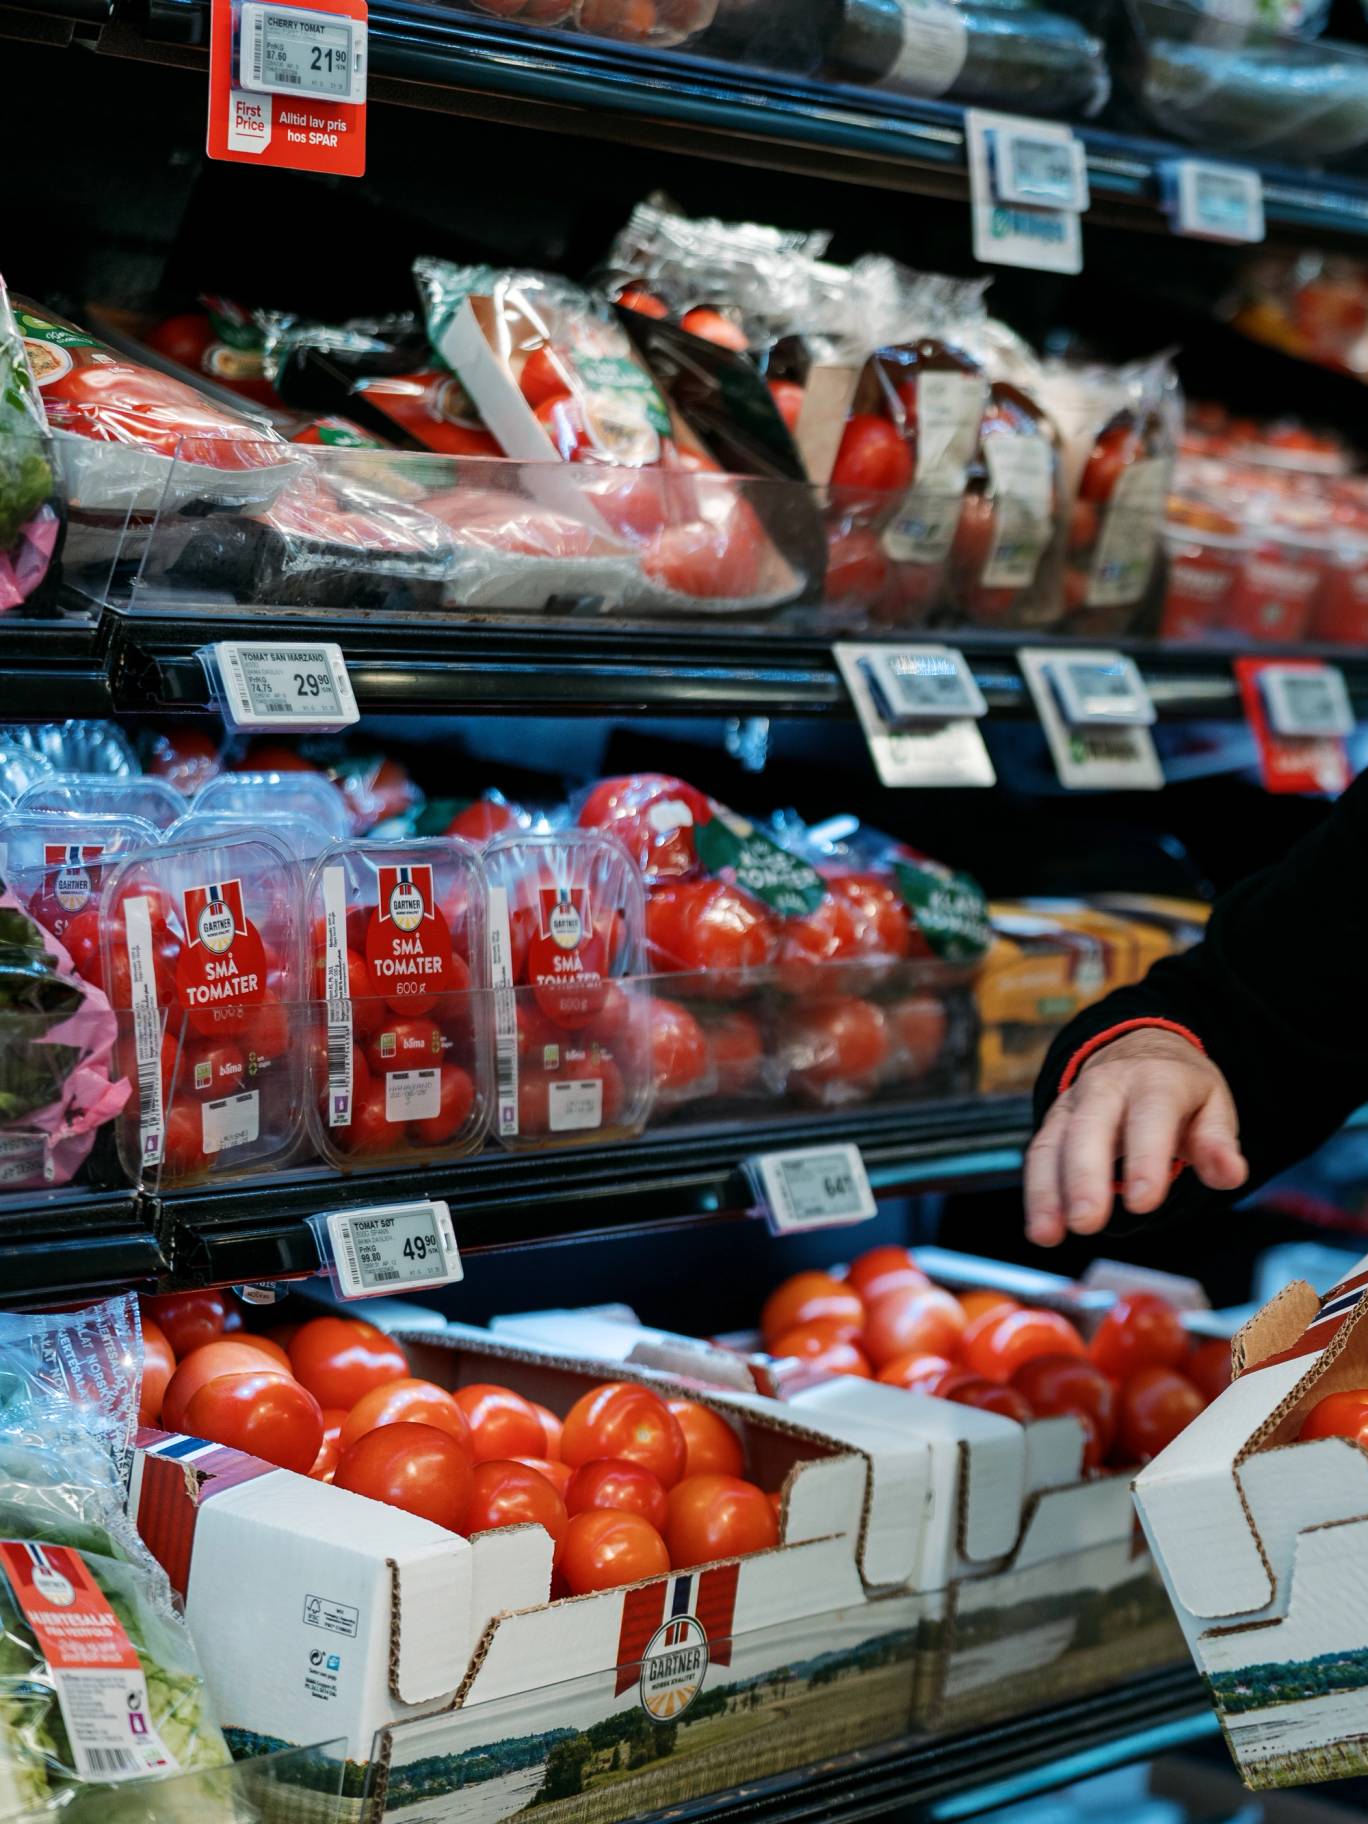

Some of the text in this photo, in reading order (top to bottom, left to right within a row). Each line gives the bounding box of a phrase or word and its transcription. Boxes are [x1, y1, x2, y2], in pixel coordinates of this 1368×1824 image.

[267, 17, 325, 34] CHERRY TOMAT
[310, 46, 332, 72] 21
[335, 50, 347, 63] 90
[235, 101, 262, 117] First
[235, 116, 265, 132] Price
[279, 111, 347, 132] Alltid lav pris
[287, 130, 338, 147] hos SPAR
[242, 653, 324, 662] TOMAT SAN MARZANO
[251, 684, 272, 693] 74.75
[293, 673, 329, 696] 29 90
[58, 879, 88, 892] GARTNER
[393, 899, 420, 911] GARTNER
[203, 918, 232, 933] GARTNER
[392, 932, 424, 955] SMÅ
[204, 952, 239, 981] SMÅ
[374, 956, 443, 977] TOMATER
[553, 950, 583, 972] SMÅ
[186, 974, 258, 1005] TOMATER
[396, 982, 418, 995] 600
[354, 1218, 395, 1231] TOMAT SØT
[403, 1234, 436, 1260] 49 90
[361, 1252, 382, 1263] 99.80
[648, 1650, 700, 1681] GARTNER
